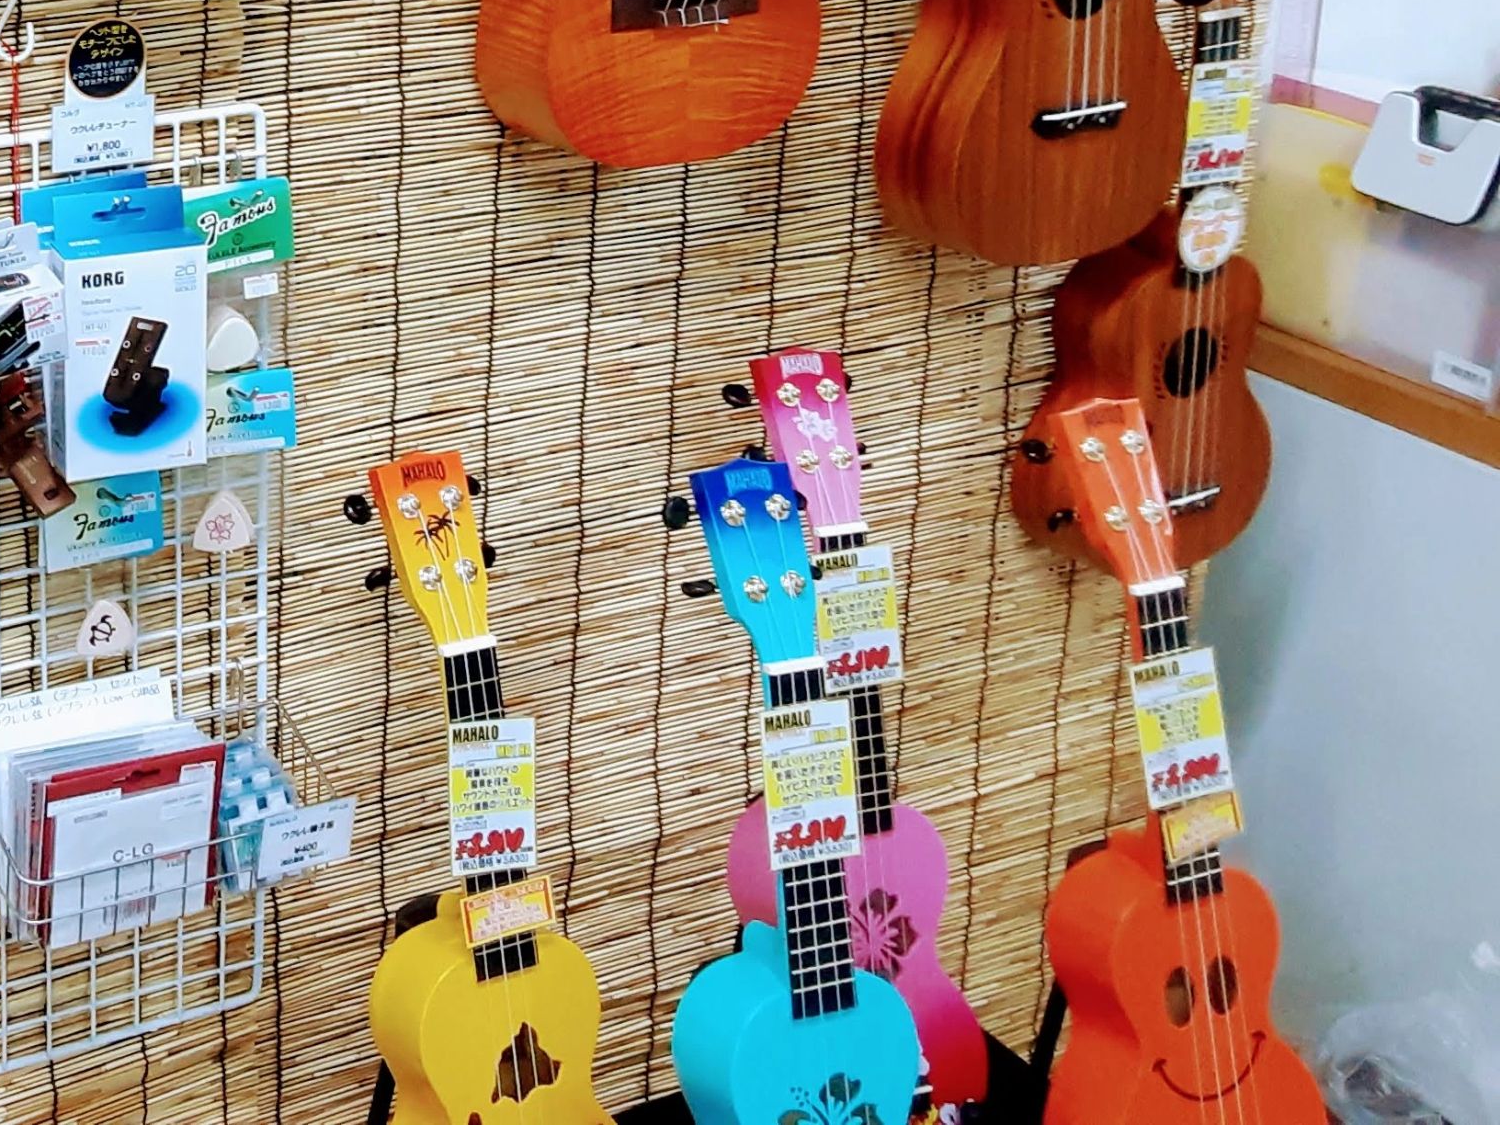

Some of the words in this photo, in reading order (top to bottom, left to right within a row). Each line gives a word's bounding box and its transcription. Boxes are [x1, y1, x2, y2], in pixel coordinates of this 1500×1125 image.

[86, 139, 122, 153] ¥1,800
[199, 196, 276, 247] Famous
[81, 271, 125, 290] KORG
[175, 263, 198, 278] 20
[400, 459, 447, 488] MAHALO
[73, 513, 136, 542] Famous
[816, 554, 859, 571] MAHALO
[764, 709, 812, 733] MAHALO
[453, 725, 499, 746] MAHALO
